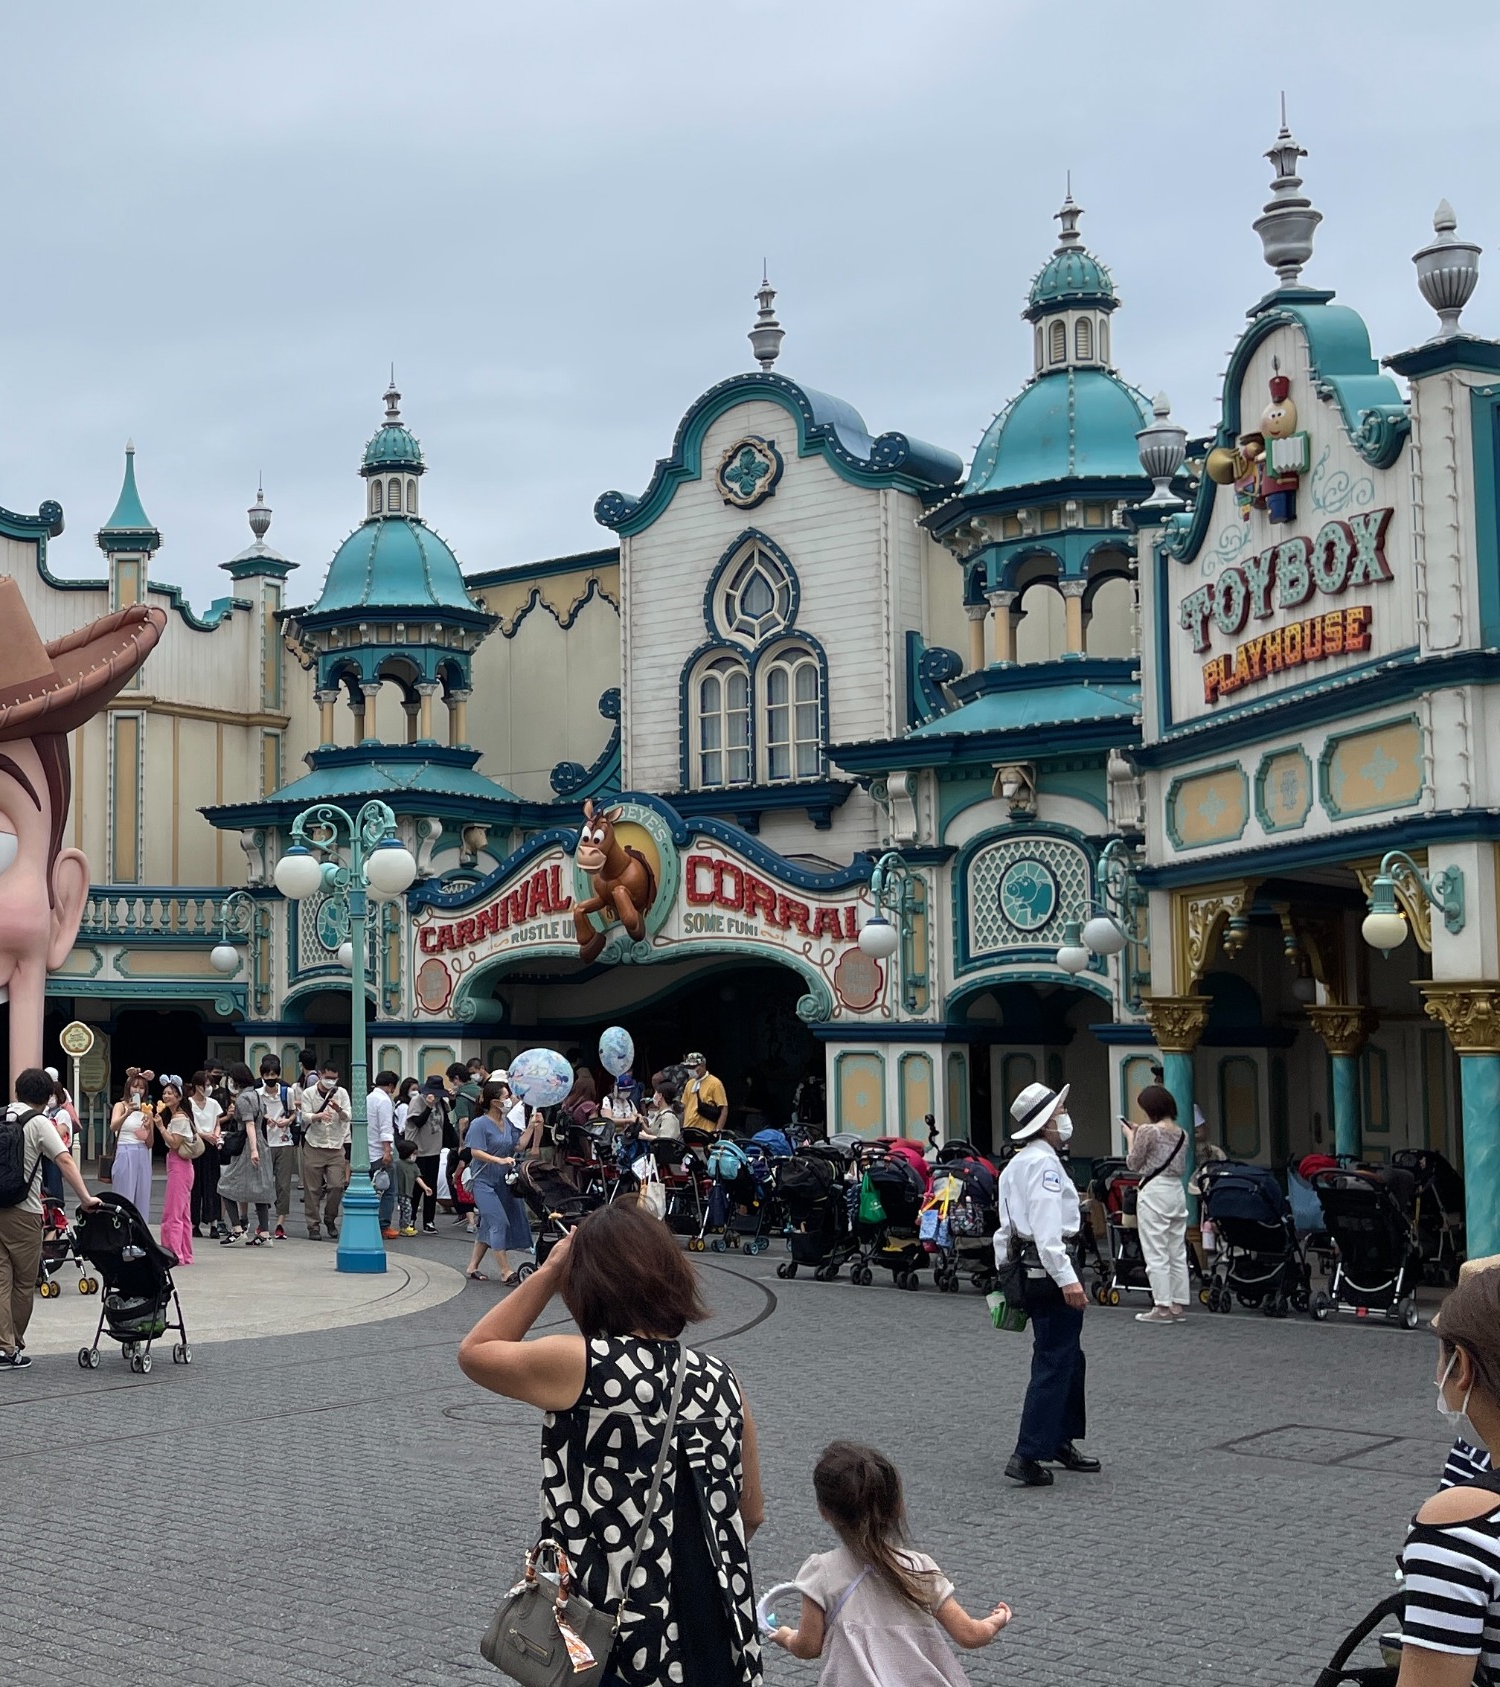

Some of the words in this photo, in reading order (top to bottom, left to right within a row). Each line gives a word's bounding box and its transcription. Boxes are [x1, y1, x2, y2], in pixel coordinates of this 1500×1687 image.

[1181, 507, 1394, 654] TOYBOX
[1203, 605, 1373, 704] PLAYHOUSE
[419, 864, 572, 954] CARNIVAL
[686, 855, 861, 939] CORRAL
[511, 921, 559, 944] RUSTLE
[683, 913, 724, 934] SOME
[727, 917, 758, 936] FUN!
